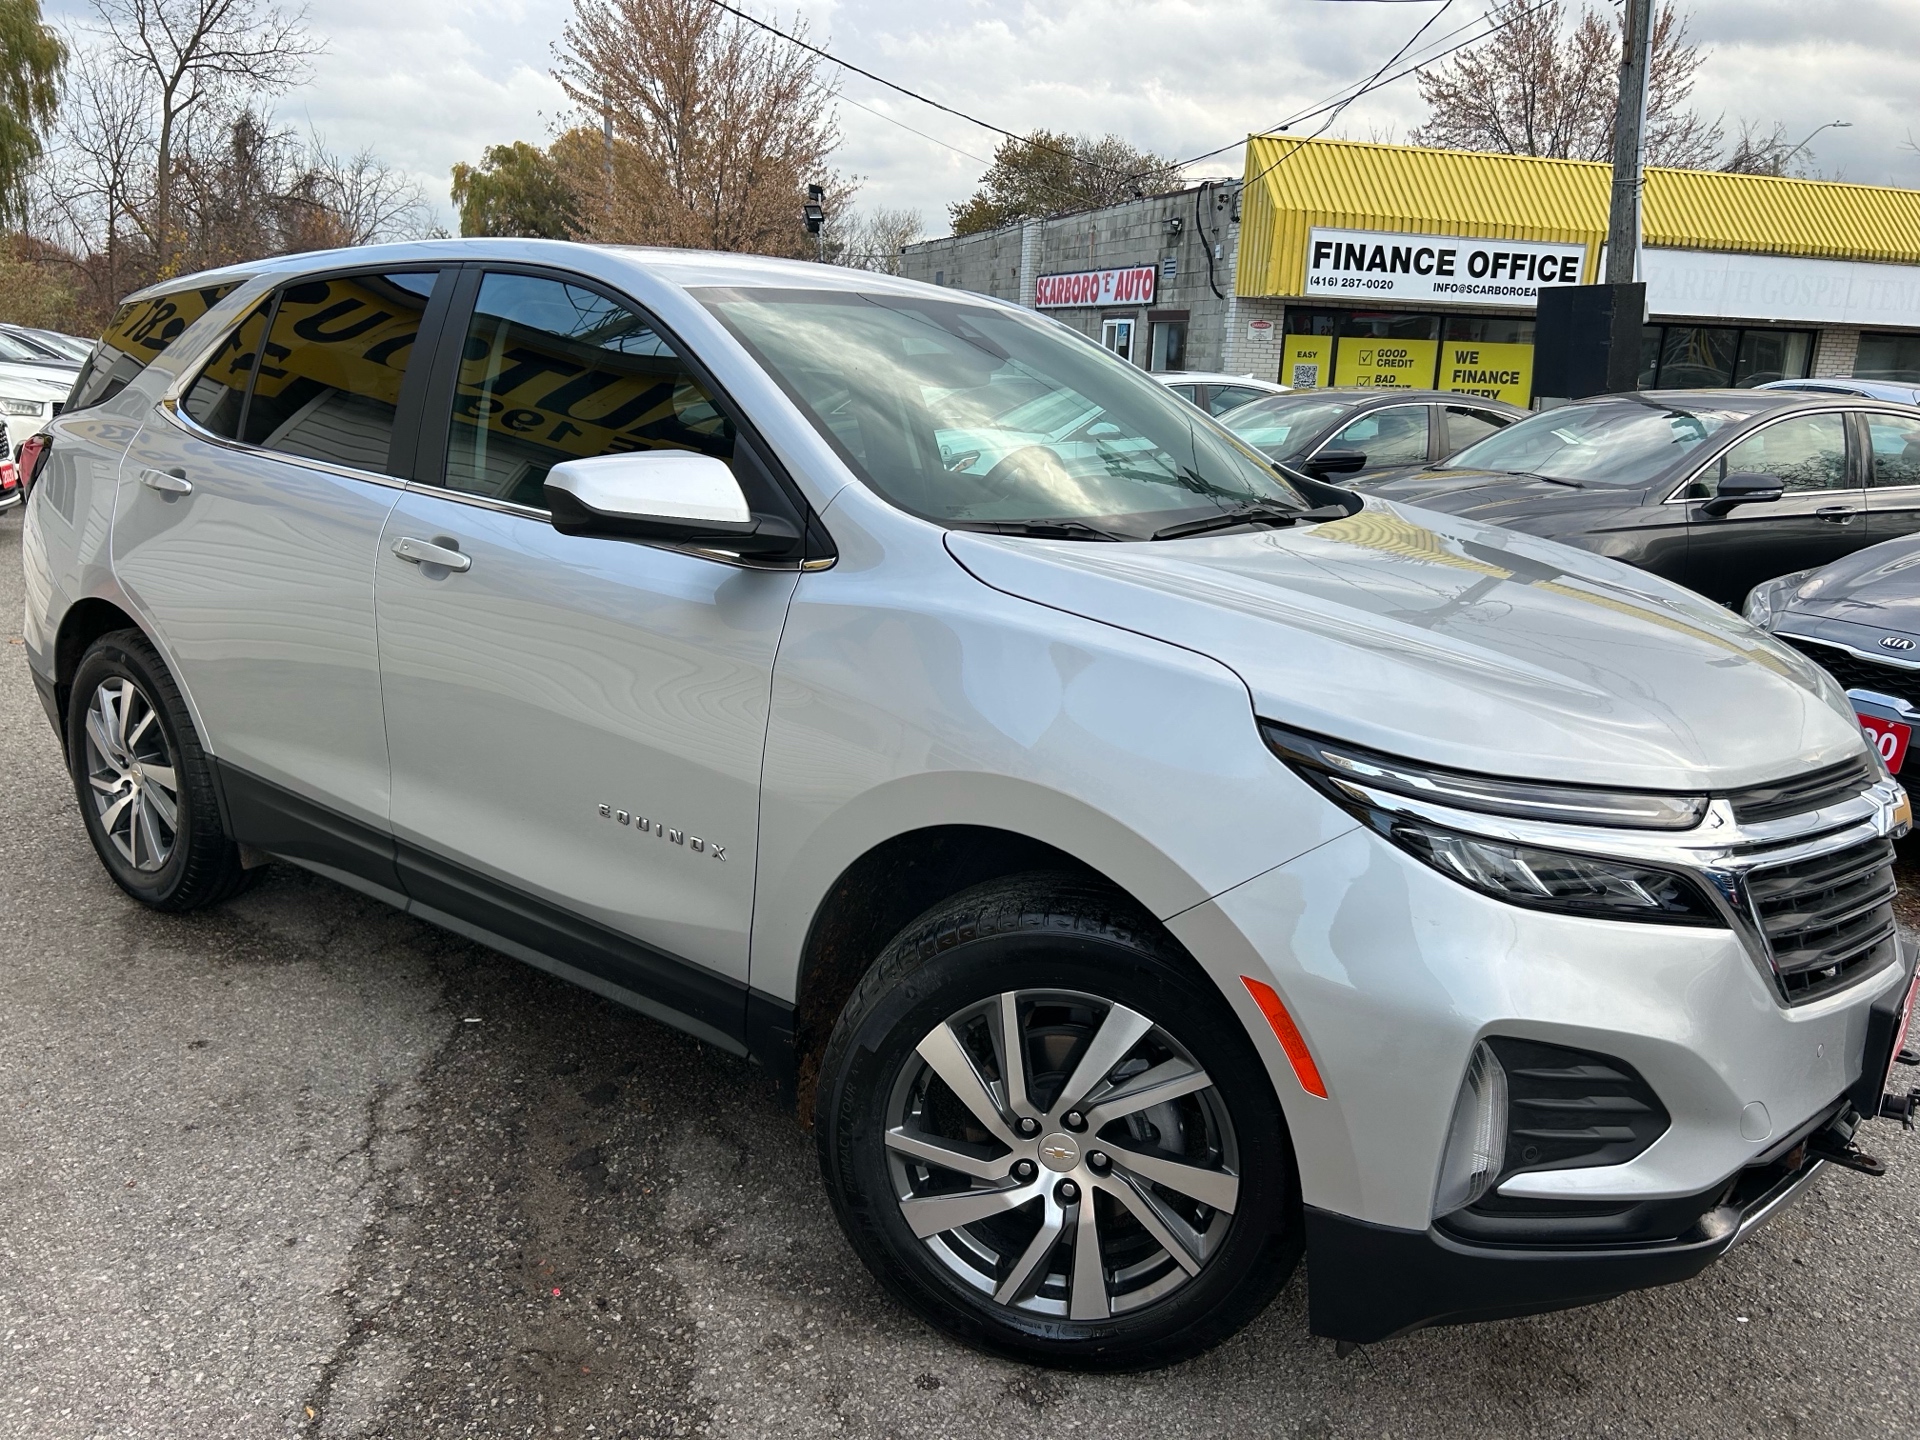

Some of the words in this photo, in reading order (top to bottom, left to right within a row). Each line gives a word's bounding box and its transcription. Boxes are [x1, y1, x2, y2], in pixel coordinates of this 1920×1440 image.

[1312, 241, 1457, 276] FINANCE
[1467, 250, 1579, 283] OFFICE
[1036, 273, 1099, 306] SCARBORO
[1114, 268, 1154, 301] AUTO
[1310, 275, 1338, 288] (416)
[1341, 278, 1394, 290] 287-0020
[1761, 273, 1860, 309] GOSPEL
[1864, 278, 1920, 312] TEM
[1378, 349, 1407, 358] GOOD
[1455, 350, 1479, 364] WE
[1376, 359, 1414, 368] CREDIT
[1374, 375, 1396, 383] BAD
[1452, 370, 1520, 385] FINANCE
[1451, 388, 1501, 400] ERY
[1882, 636, 1908, 649] KIA
[598, 803, 727, 862] EQUINOX
